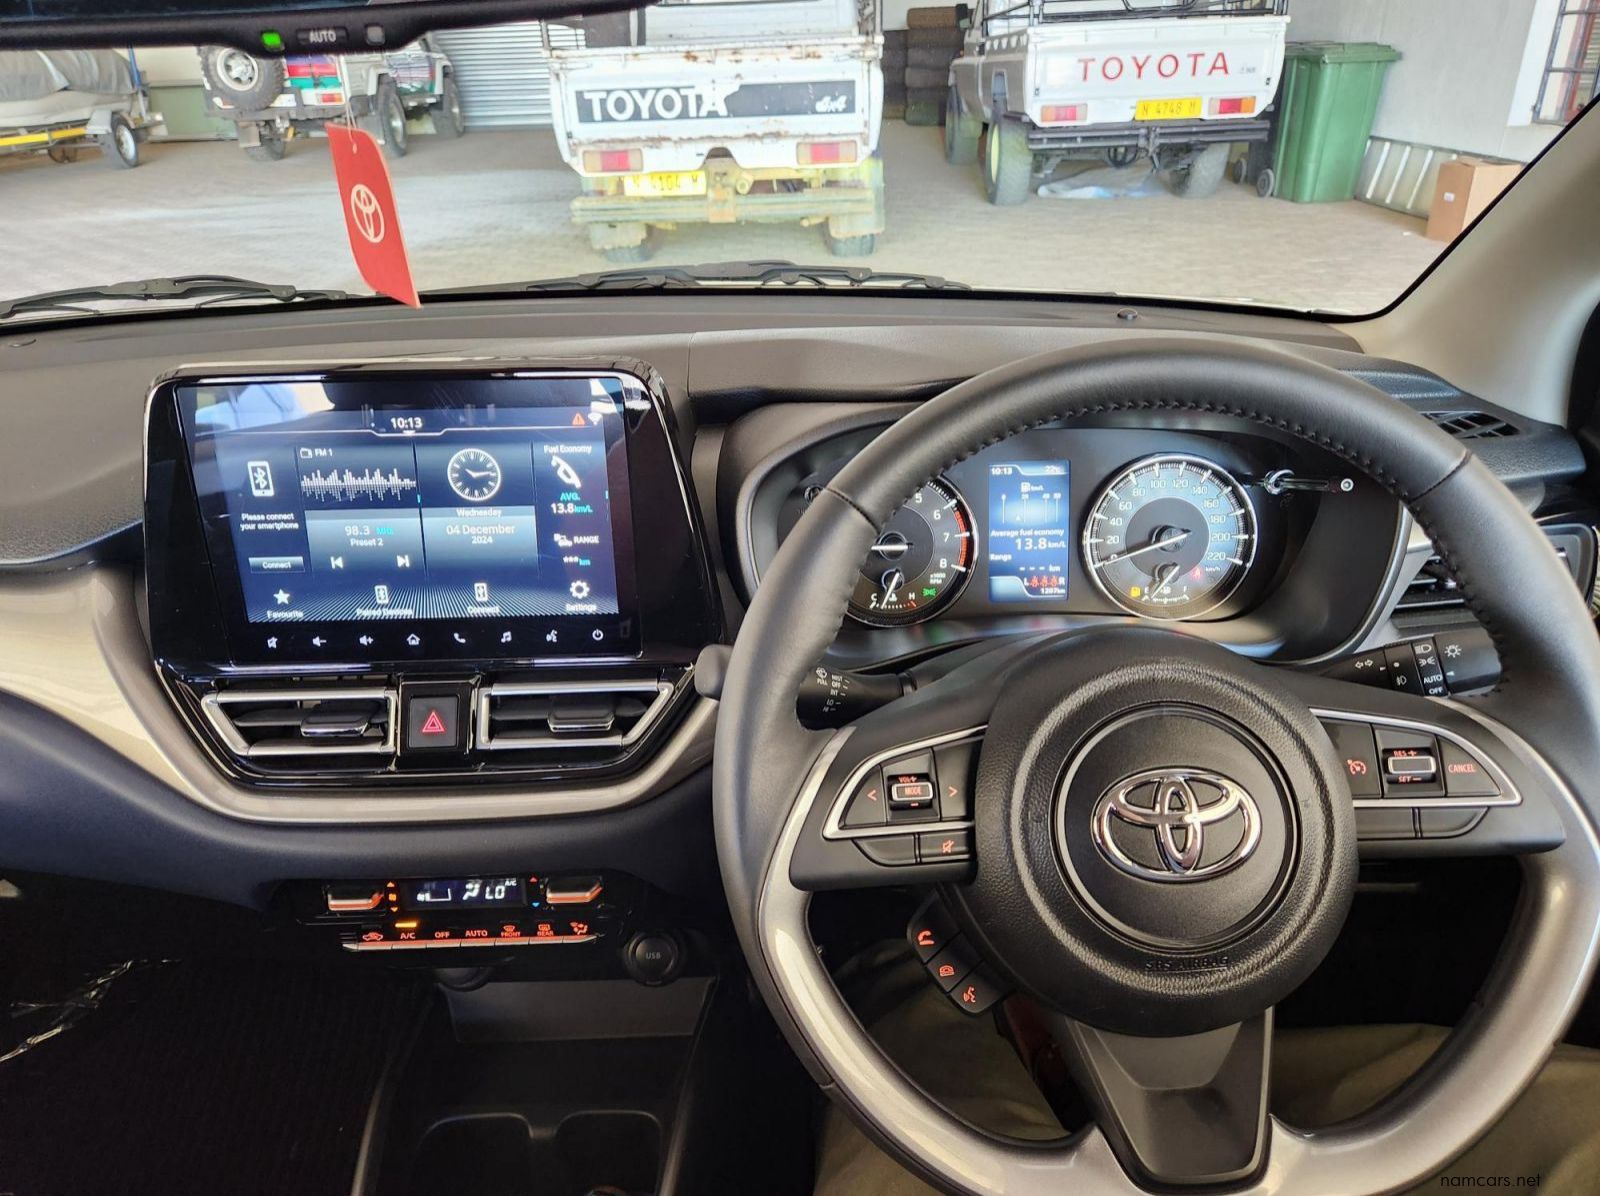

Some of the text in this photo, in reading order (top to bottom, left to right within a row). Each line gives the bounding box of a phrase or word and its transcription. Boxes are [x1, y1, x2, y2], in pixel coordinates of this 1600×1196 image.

[310, 30, 336, 43] AUTO
[1078, 51, 1229, 82] TOYOTA
[583, 83, 728, 121] TOYOTA
[390, 416, 423, 430] 10:13
[315, 448, 326, 457] FM
[543, 444, 592, 454] Fuel Economy
[1150, 480, 1166, 489] 100
[1172, 479, 1188, 488] 120
[1132, 488, 1146, 497] 80
[1191, 486, 1207, 495] 140
[915, 493, 922, 503] 5
[1119, 501, 1133, 511] 60
[1203, 499, 1219, 508] 160
[241, 513, 295, 521] Please connect
[456, 508, 502, 518] Wednesday
[933, 510, 941, 520] 6
[1109, 517, 1123, 526] 40
[1210, 514, 1226, 524] 180
[240, 521, 299, 531] your smartphone
[446, 524, 516, 535] 04 December
[345, 525, 370, 537] 98.3
[990, 528, 1064, 538] Average fuel economy
[471, 535, 493, 544] 2024
[573, 535, 599, 544] RANGE
[943, 533, 950, 543] 7
[1106, 536, 1120, 545] 20
[1211, 532, 1230, 541] 200
[350, 538, 384, 547] Preset 2
[1015, 538, 1047, 550] 13.8
[990, 553, 1012, 562] Range
[1206, 551, 1226, 561] 220
[262, 561, 292, 570] Connect
[939, 558, 947, 569] 8
[870, 593, 877, 601] C
[909, 592, 915, 600] H
[565, 604, 597, 613] Settings
[266, 610, 304, 618] Favourite
[1423, 674, 1443, 684] AUTO
[1429, 687, 1444, 695] OFF
[1448, 764, 1476, 774] CANCEL
[485, 885, 505, 900] LO
[400, 932, 416, 940] A/C
[434, 931, 450, 939] OFF
[465, 929, 488, 937] AUTO
[645, 951, 661, 960] USB
